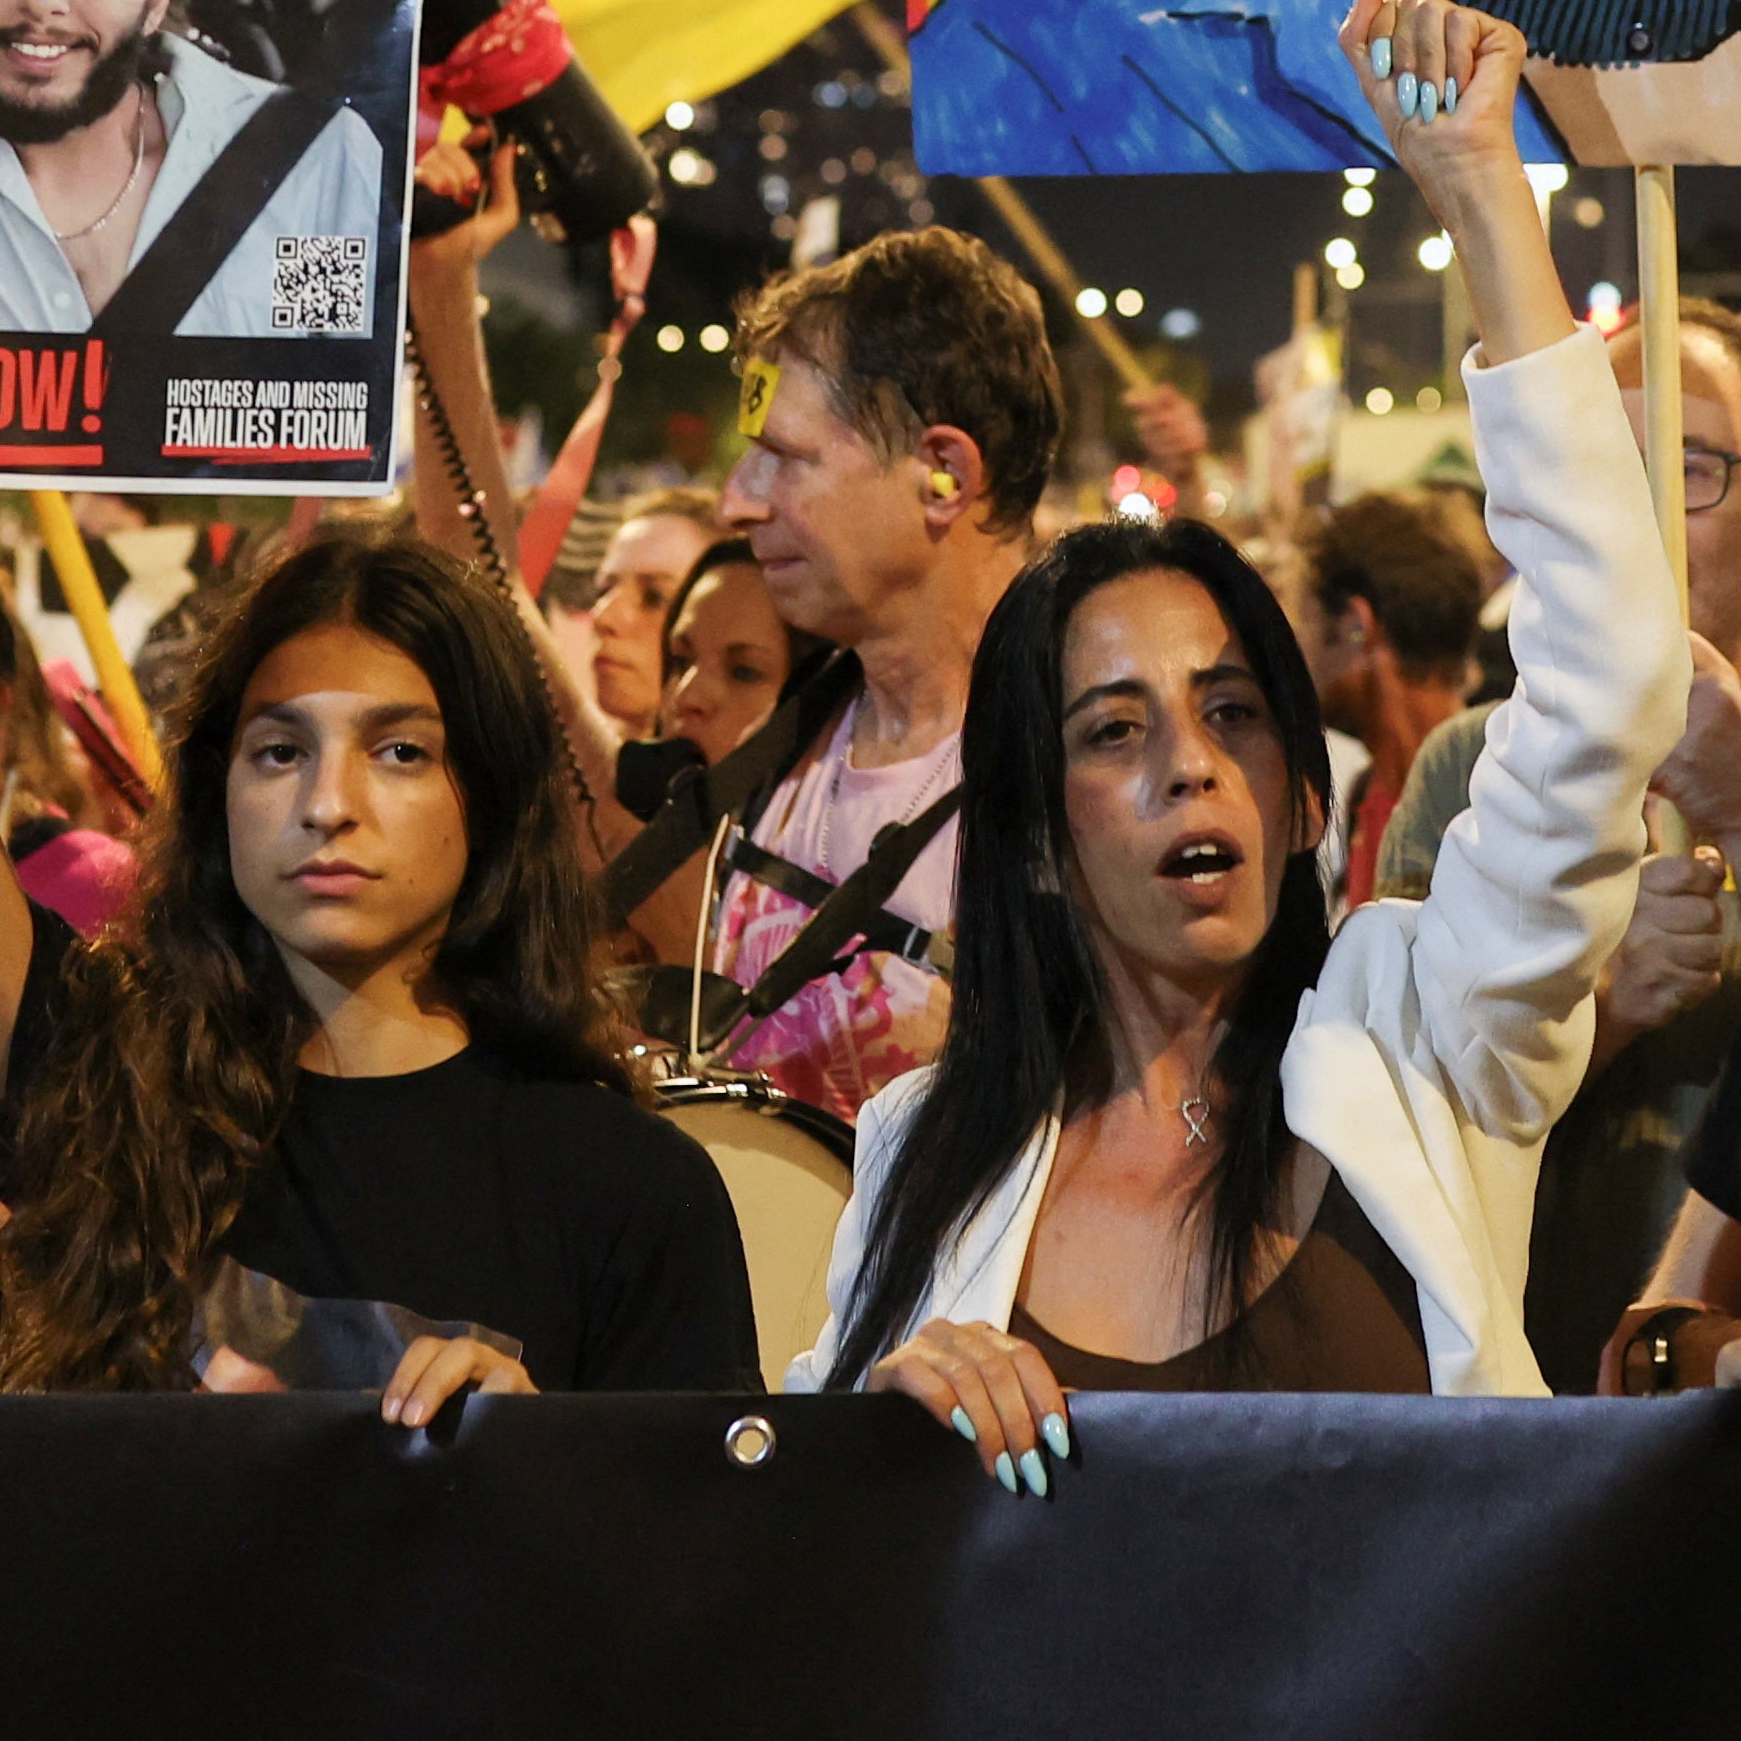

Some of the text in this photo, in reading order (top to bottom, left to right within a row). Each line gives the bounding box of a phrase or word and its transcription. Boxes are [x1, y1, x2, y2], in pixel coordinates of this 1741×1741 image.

[166, 378, 369, 410] HOSTAGES AND MISSING
[164, 408, 367, 451] FAMILIES FORUM
